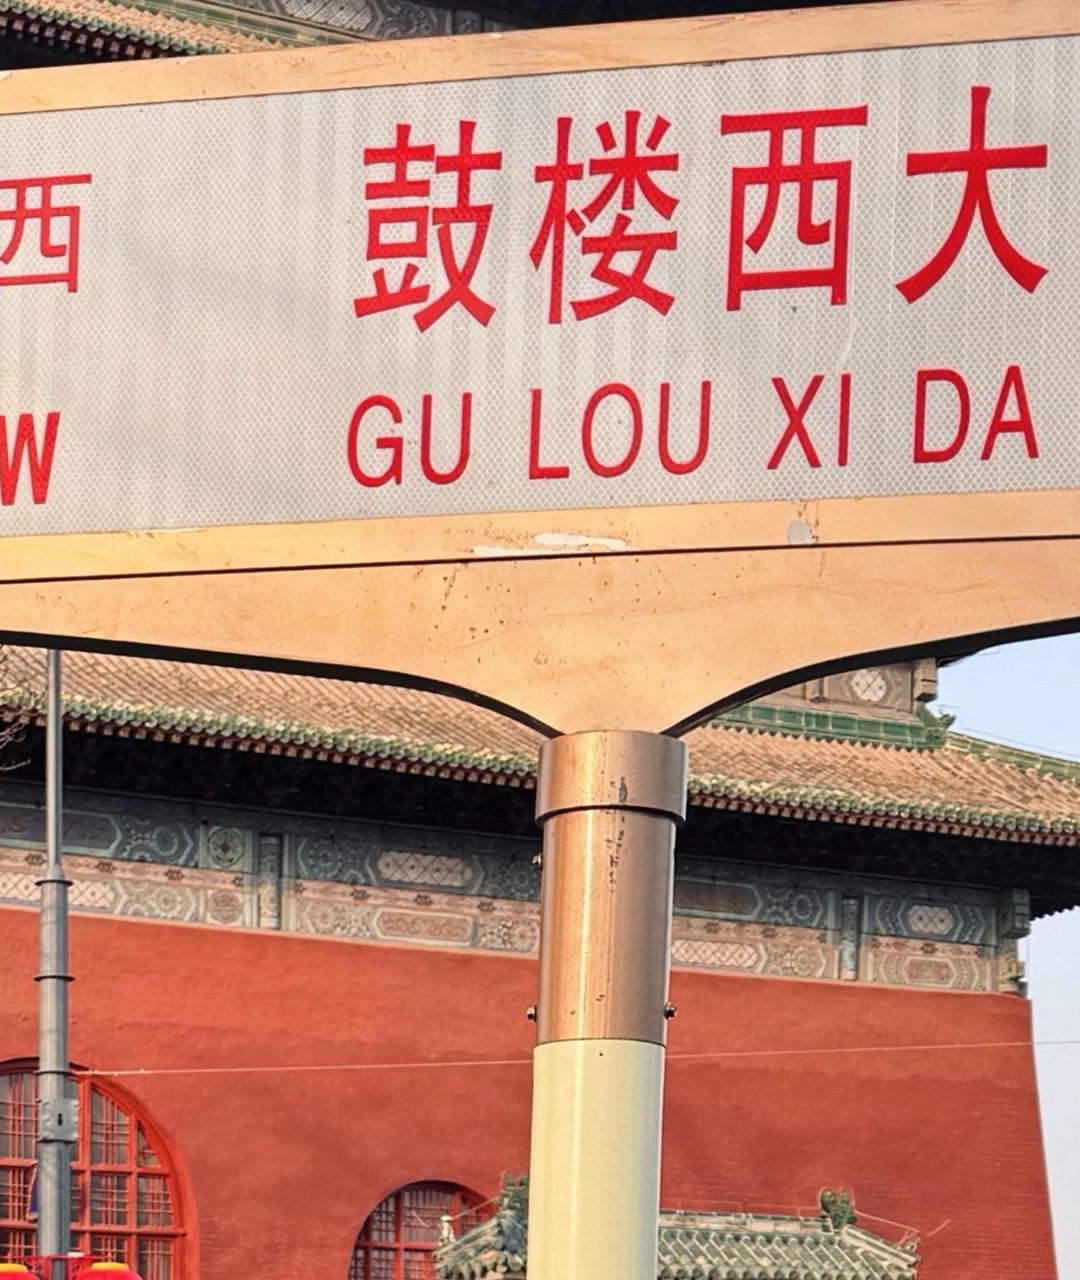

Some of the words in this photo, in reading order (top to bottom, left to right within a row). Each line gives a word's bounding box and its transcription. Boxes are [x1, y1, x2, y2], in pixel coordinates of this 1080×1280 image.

[353, 86, 1048, 332] 鼓楼西大
[347, 392, 472, 488] GU
[528, 380, 712, 480] LOU
[767, 373, 852, 470] XI
[913, 365, 1039, 464] DA
